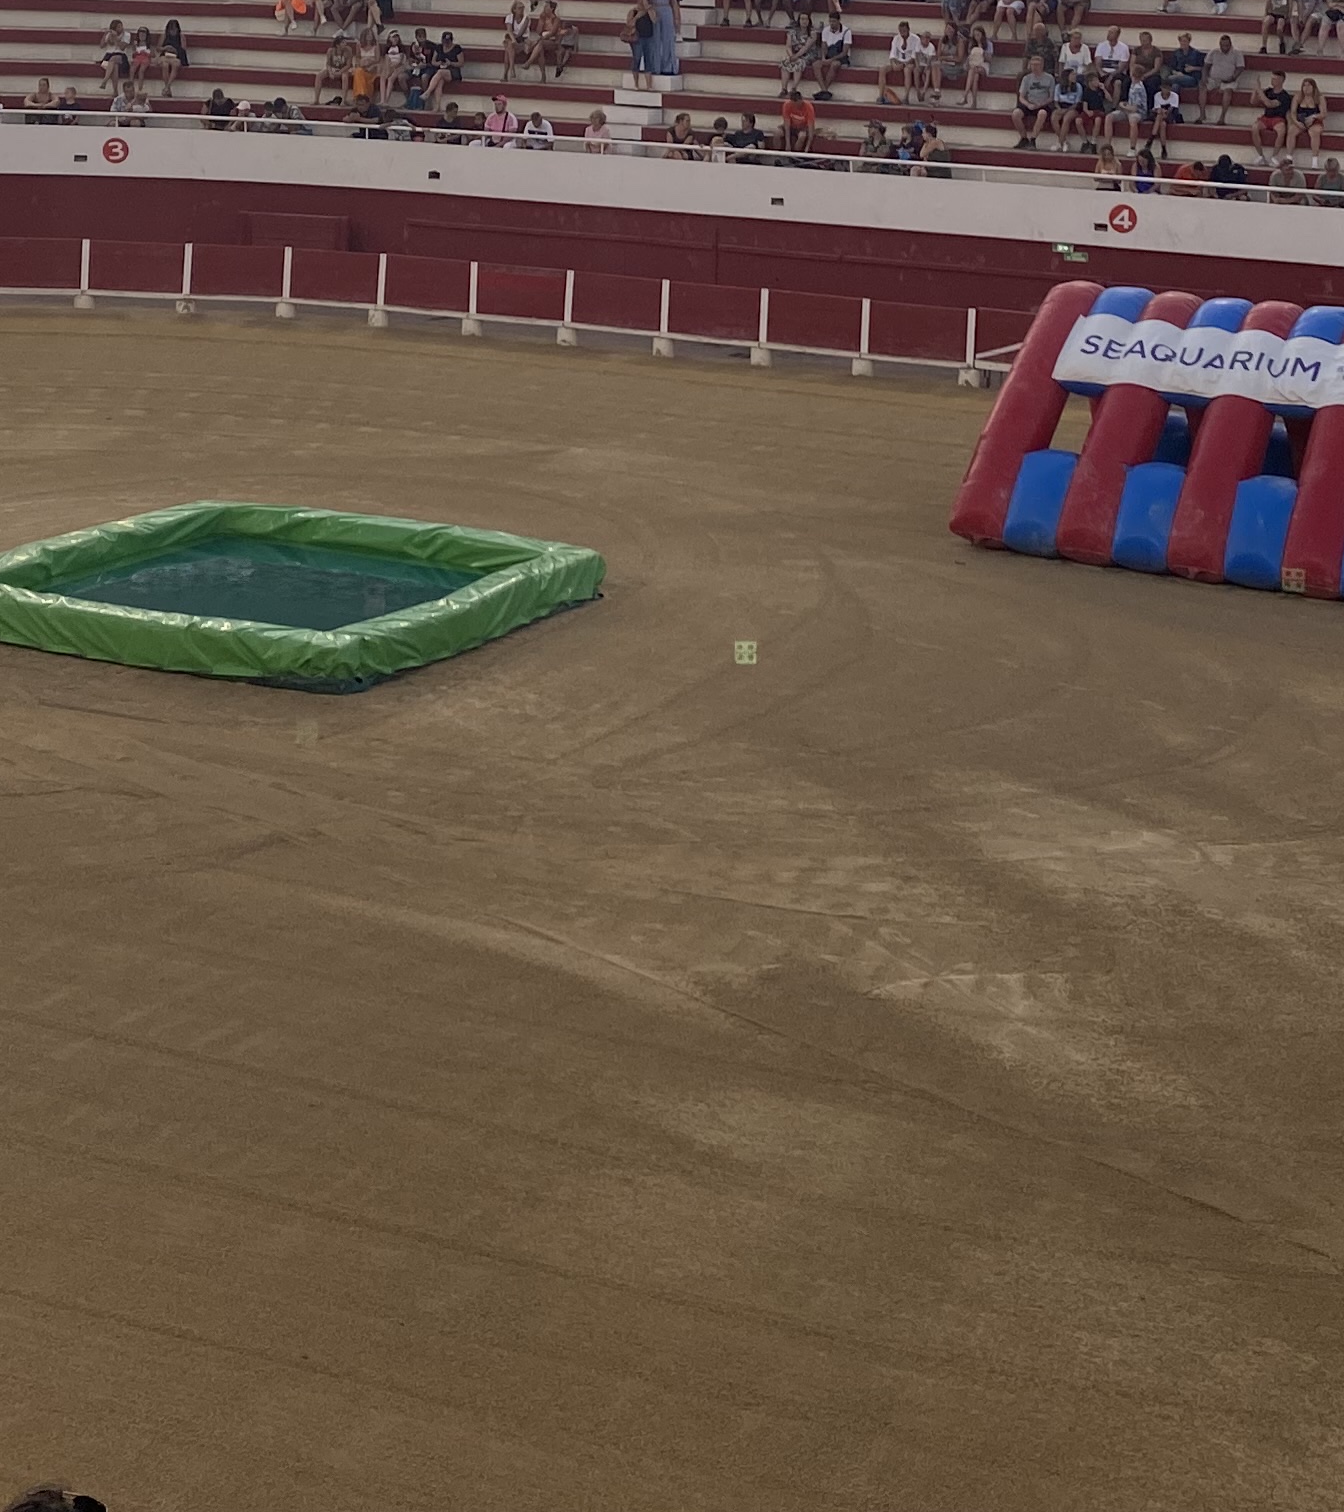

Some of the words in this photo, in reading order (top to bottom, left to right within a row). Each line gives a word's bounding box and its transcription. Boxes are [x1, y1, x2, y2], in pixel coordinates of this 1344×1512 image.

[108, 141, 125, 160] 3
[1112, 208, 1133, 230] 4
[1080, 335, 1322, 382] SEAQUARIUM
